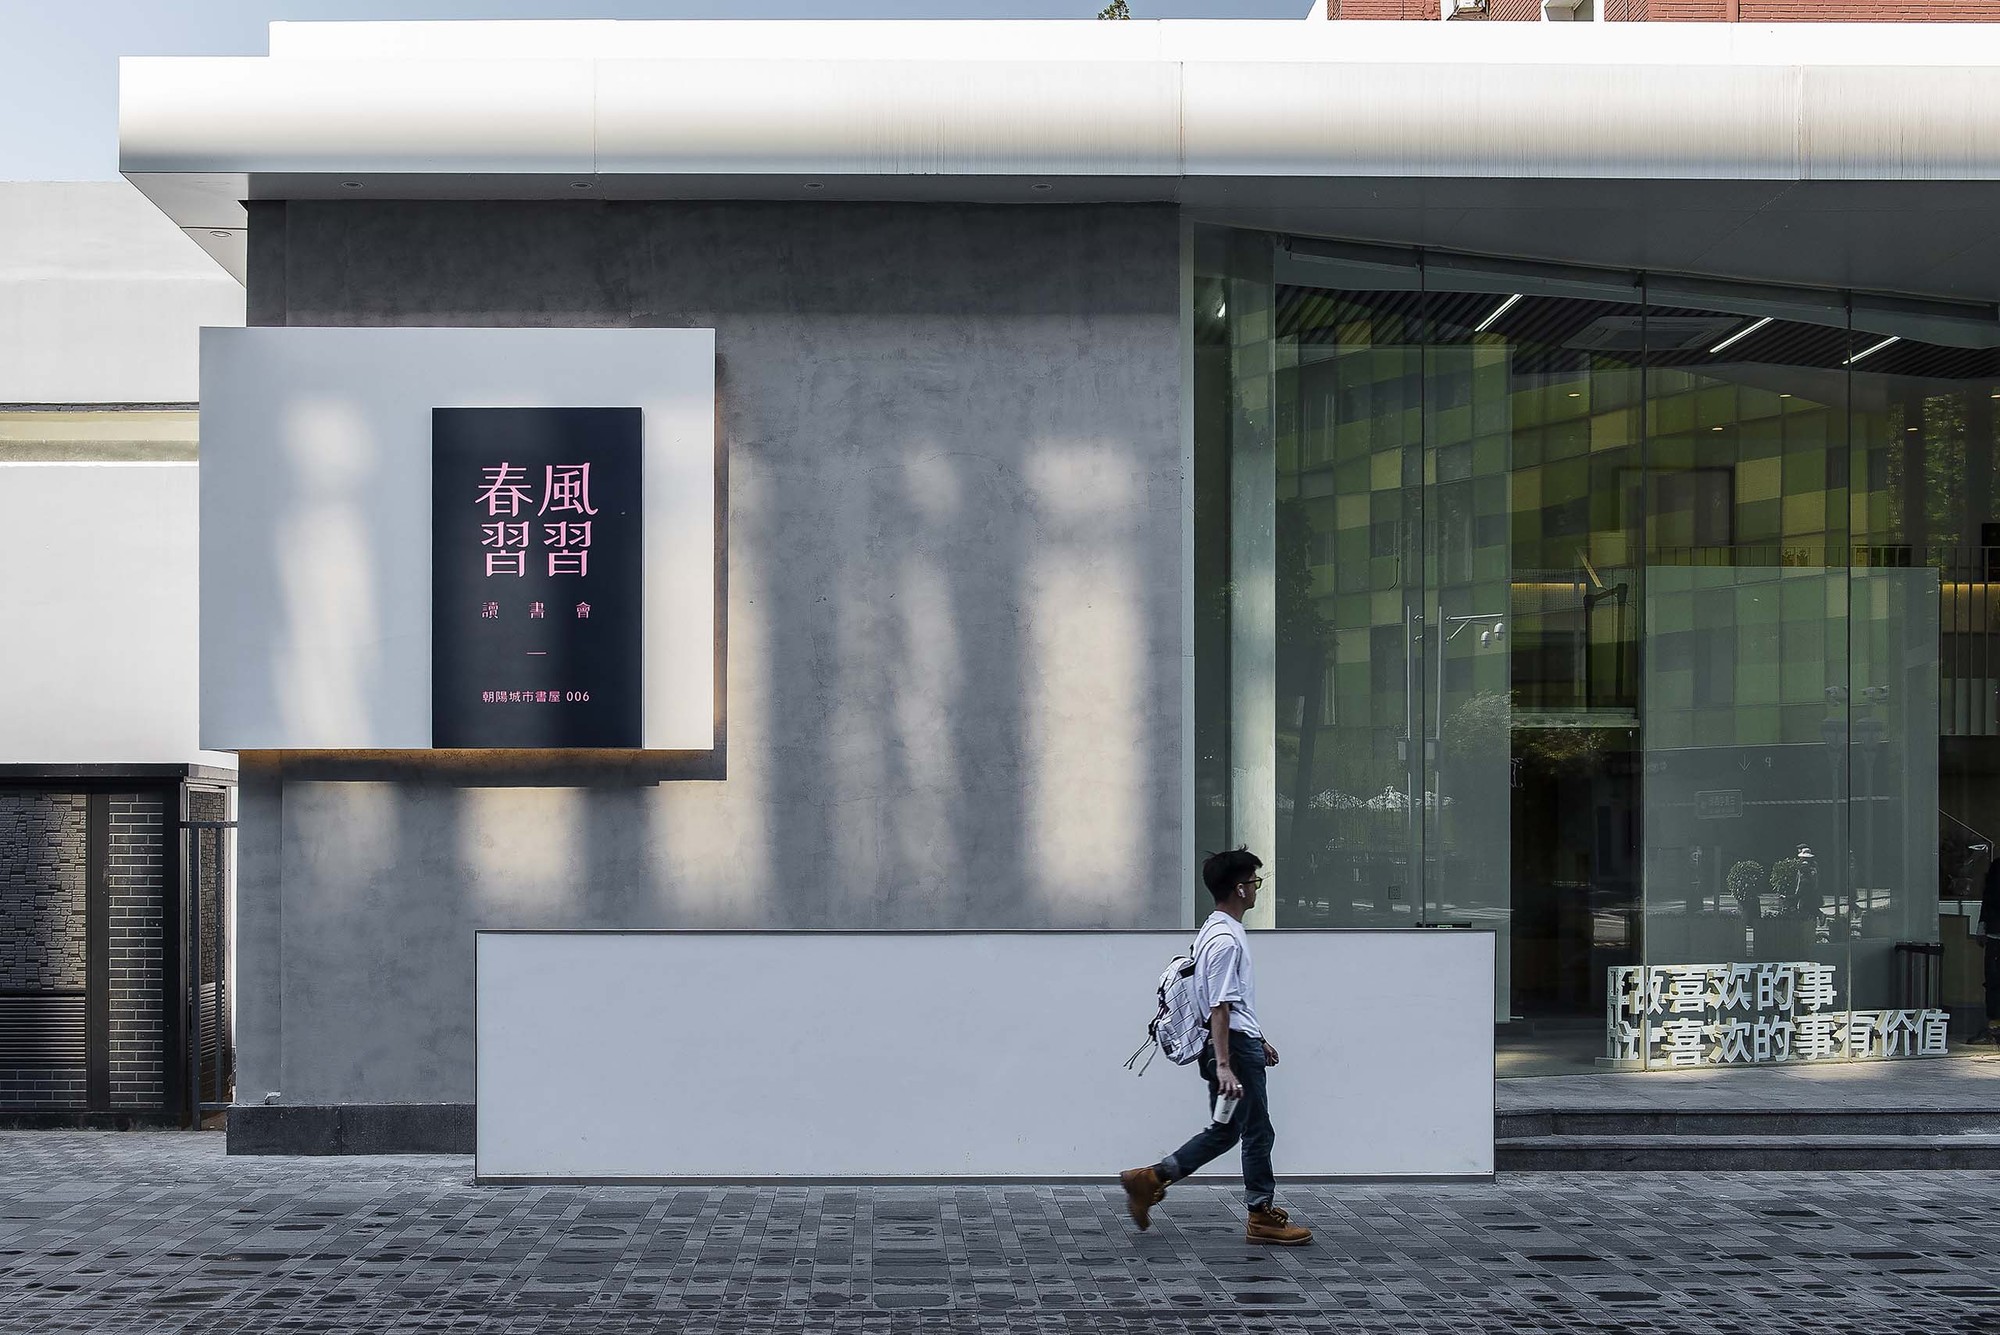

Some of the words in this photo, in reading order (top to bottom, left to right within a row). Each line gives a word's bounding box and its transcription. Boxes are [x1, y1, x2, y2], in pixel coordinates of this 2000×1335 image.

[475, 462, 599, 517] 春風
[481, 521, 592, 577] 習習
[481, 601, 592, 619] 讀書會
[482, 691, 561, 703] 朝陽城市書屋
[566, 691, 590, 702] 006
[1617, 1008, 1950, 1065] 让喜欢的事有价值
